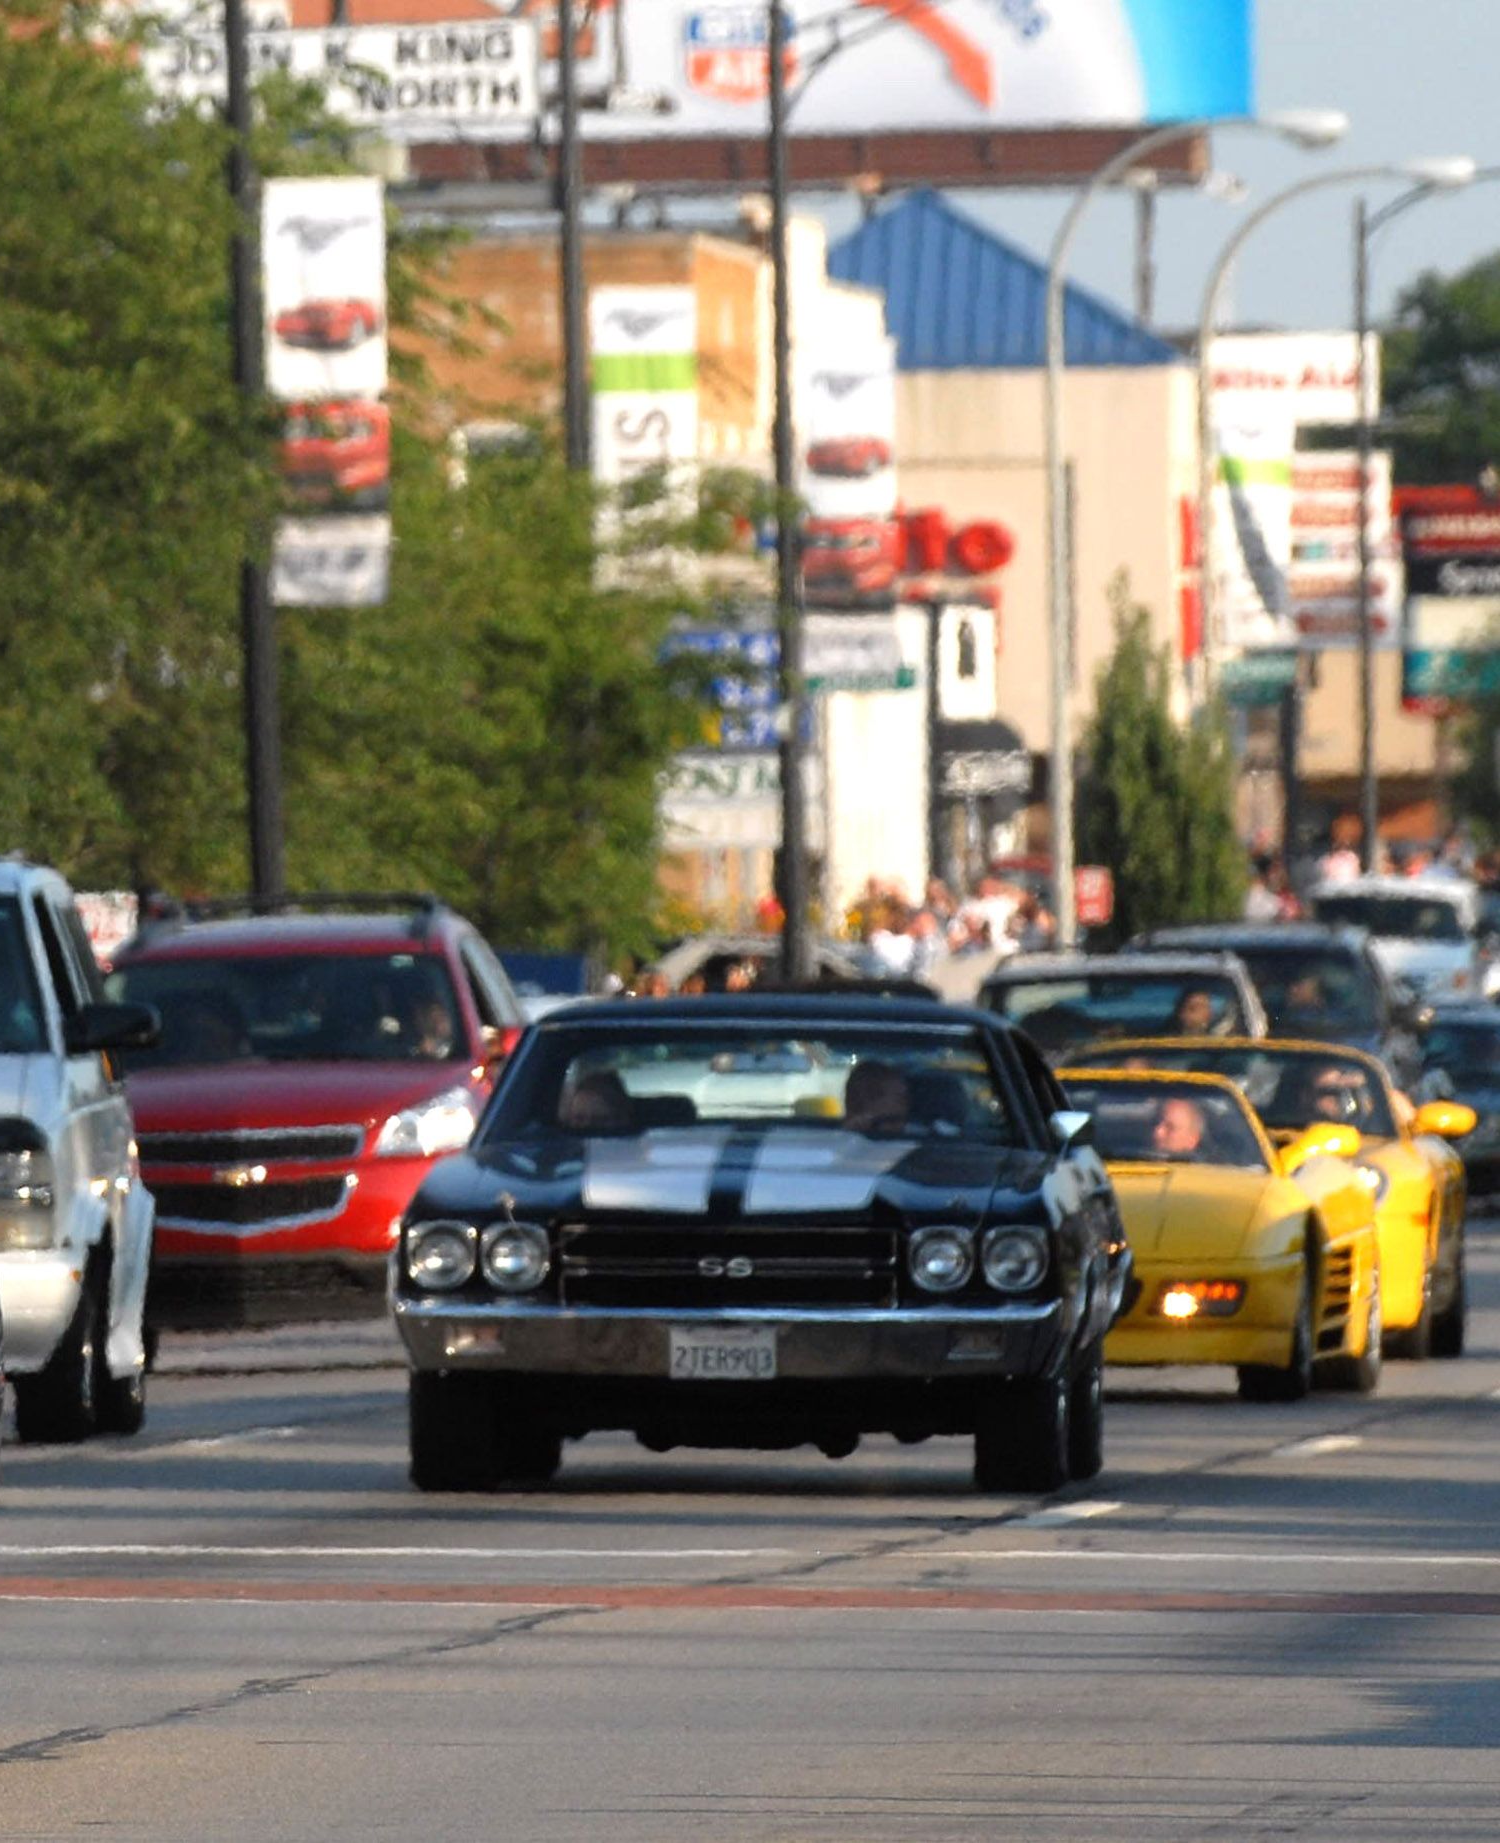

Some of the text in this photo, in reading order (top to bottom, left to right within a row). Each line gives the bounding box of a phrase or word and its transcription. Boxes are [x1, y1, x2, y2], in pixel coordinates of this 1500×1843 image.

[162, 42, 291, 76] JON
[395, 31, 513, 62] KING
[698, 1257, 753, 1278] SS
